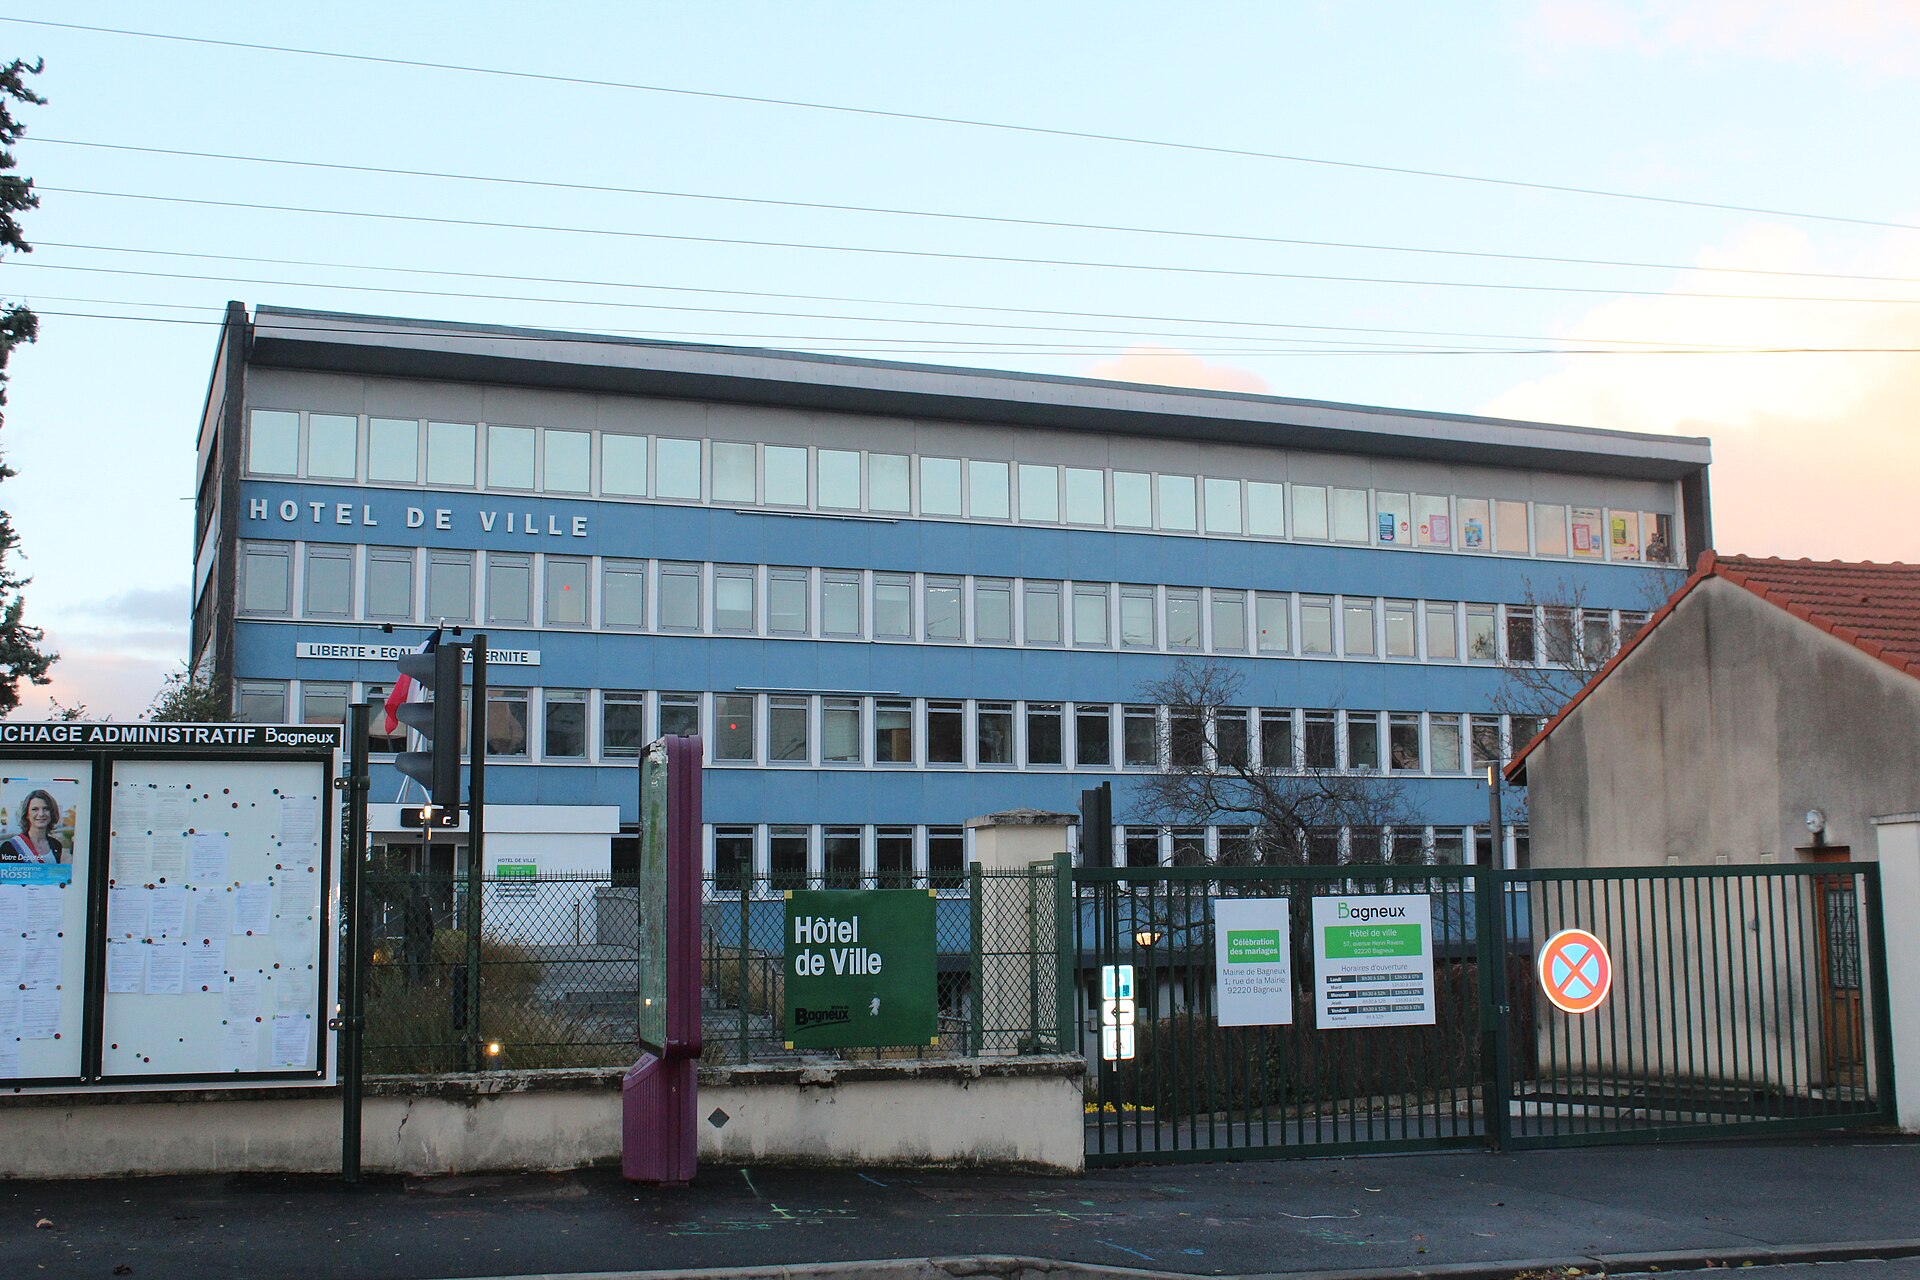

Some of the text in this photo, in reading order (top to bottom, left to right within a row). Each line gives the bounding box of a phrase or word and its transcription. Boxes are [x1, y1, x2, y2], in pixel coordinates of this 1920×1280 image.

[250, 498, 588, 537] HOTEL DE VILLE
[309, 645, 366, 658] LIBERTE
[89, 727, 256, 744] ADMINISTRATIF
[265, 727, 335, 746] Bagneux
[1, 853, 17, 861] Votre
[1338, 902, 1406, 922] Bagneux
[795, 916, 858, 944] Hôtel
[1349, 929, 1397, 938] Hôtel de ville
[1232, 938, 1275, 946] Célébration
[1245, 947, 1278, 956] mariages
[795, 948, 882, 976] de Ville
[1222, 968, 1286, 976] Mairie de Bagneux
[1370, 964, 1408, 972] d'ouverture
[1224, 978, 1231, 986] 1,
[1227, 986, 1283, 995] 92220 Bagneux
[795, 1007, 849, 1026] Bagneux
